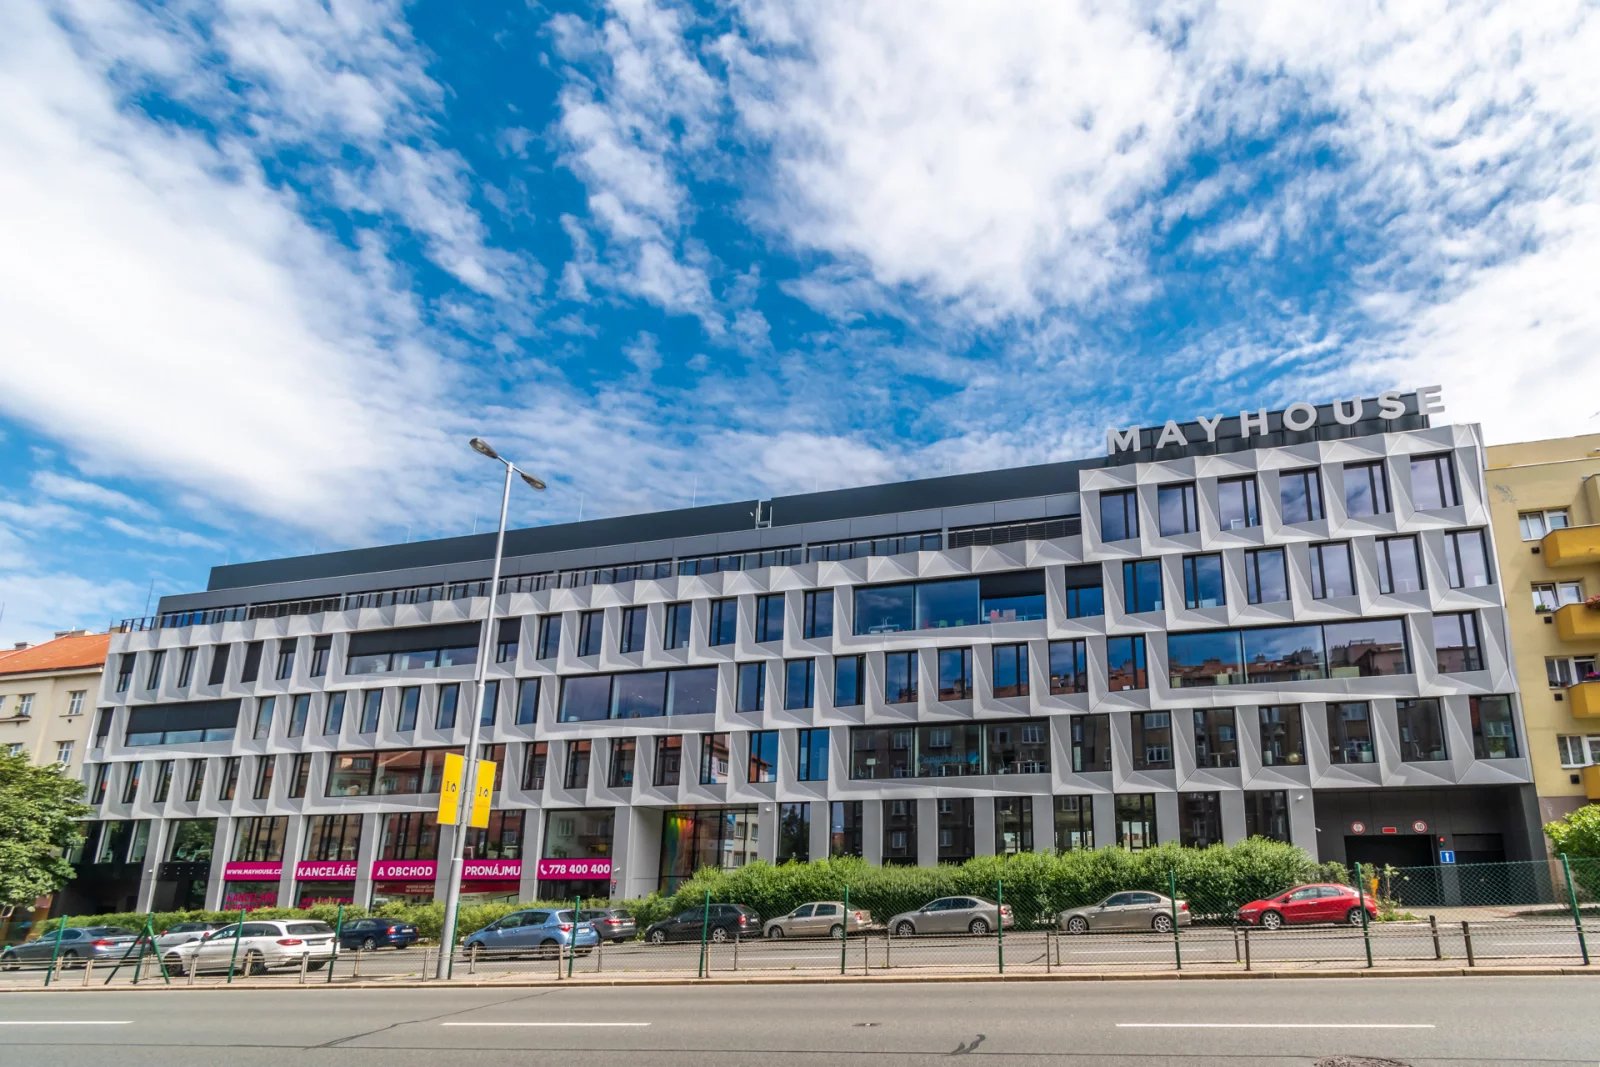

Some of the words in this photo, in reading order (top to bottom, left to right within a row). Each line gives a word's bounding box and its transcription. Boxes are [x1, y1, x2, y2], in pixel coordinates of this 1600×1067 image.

[1107, 384, 1446, 455] MAYHOUSE
[297, 864, 356, 877] KANCELÁŘE
[377, 866, 384, 876] A
[387, 866, 433, 876] OBCHOD
[464, 864, 521, 876] PRONÁJMU
[548, 864, 566, 874] 778
[569, 864, 588, 874] 400
[590, 864, 610, 874] 400
